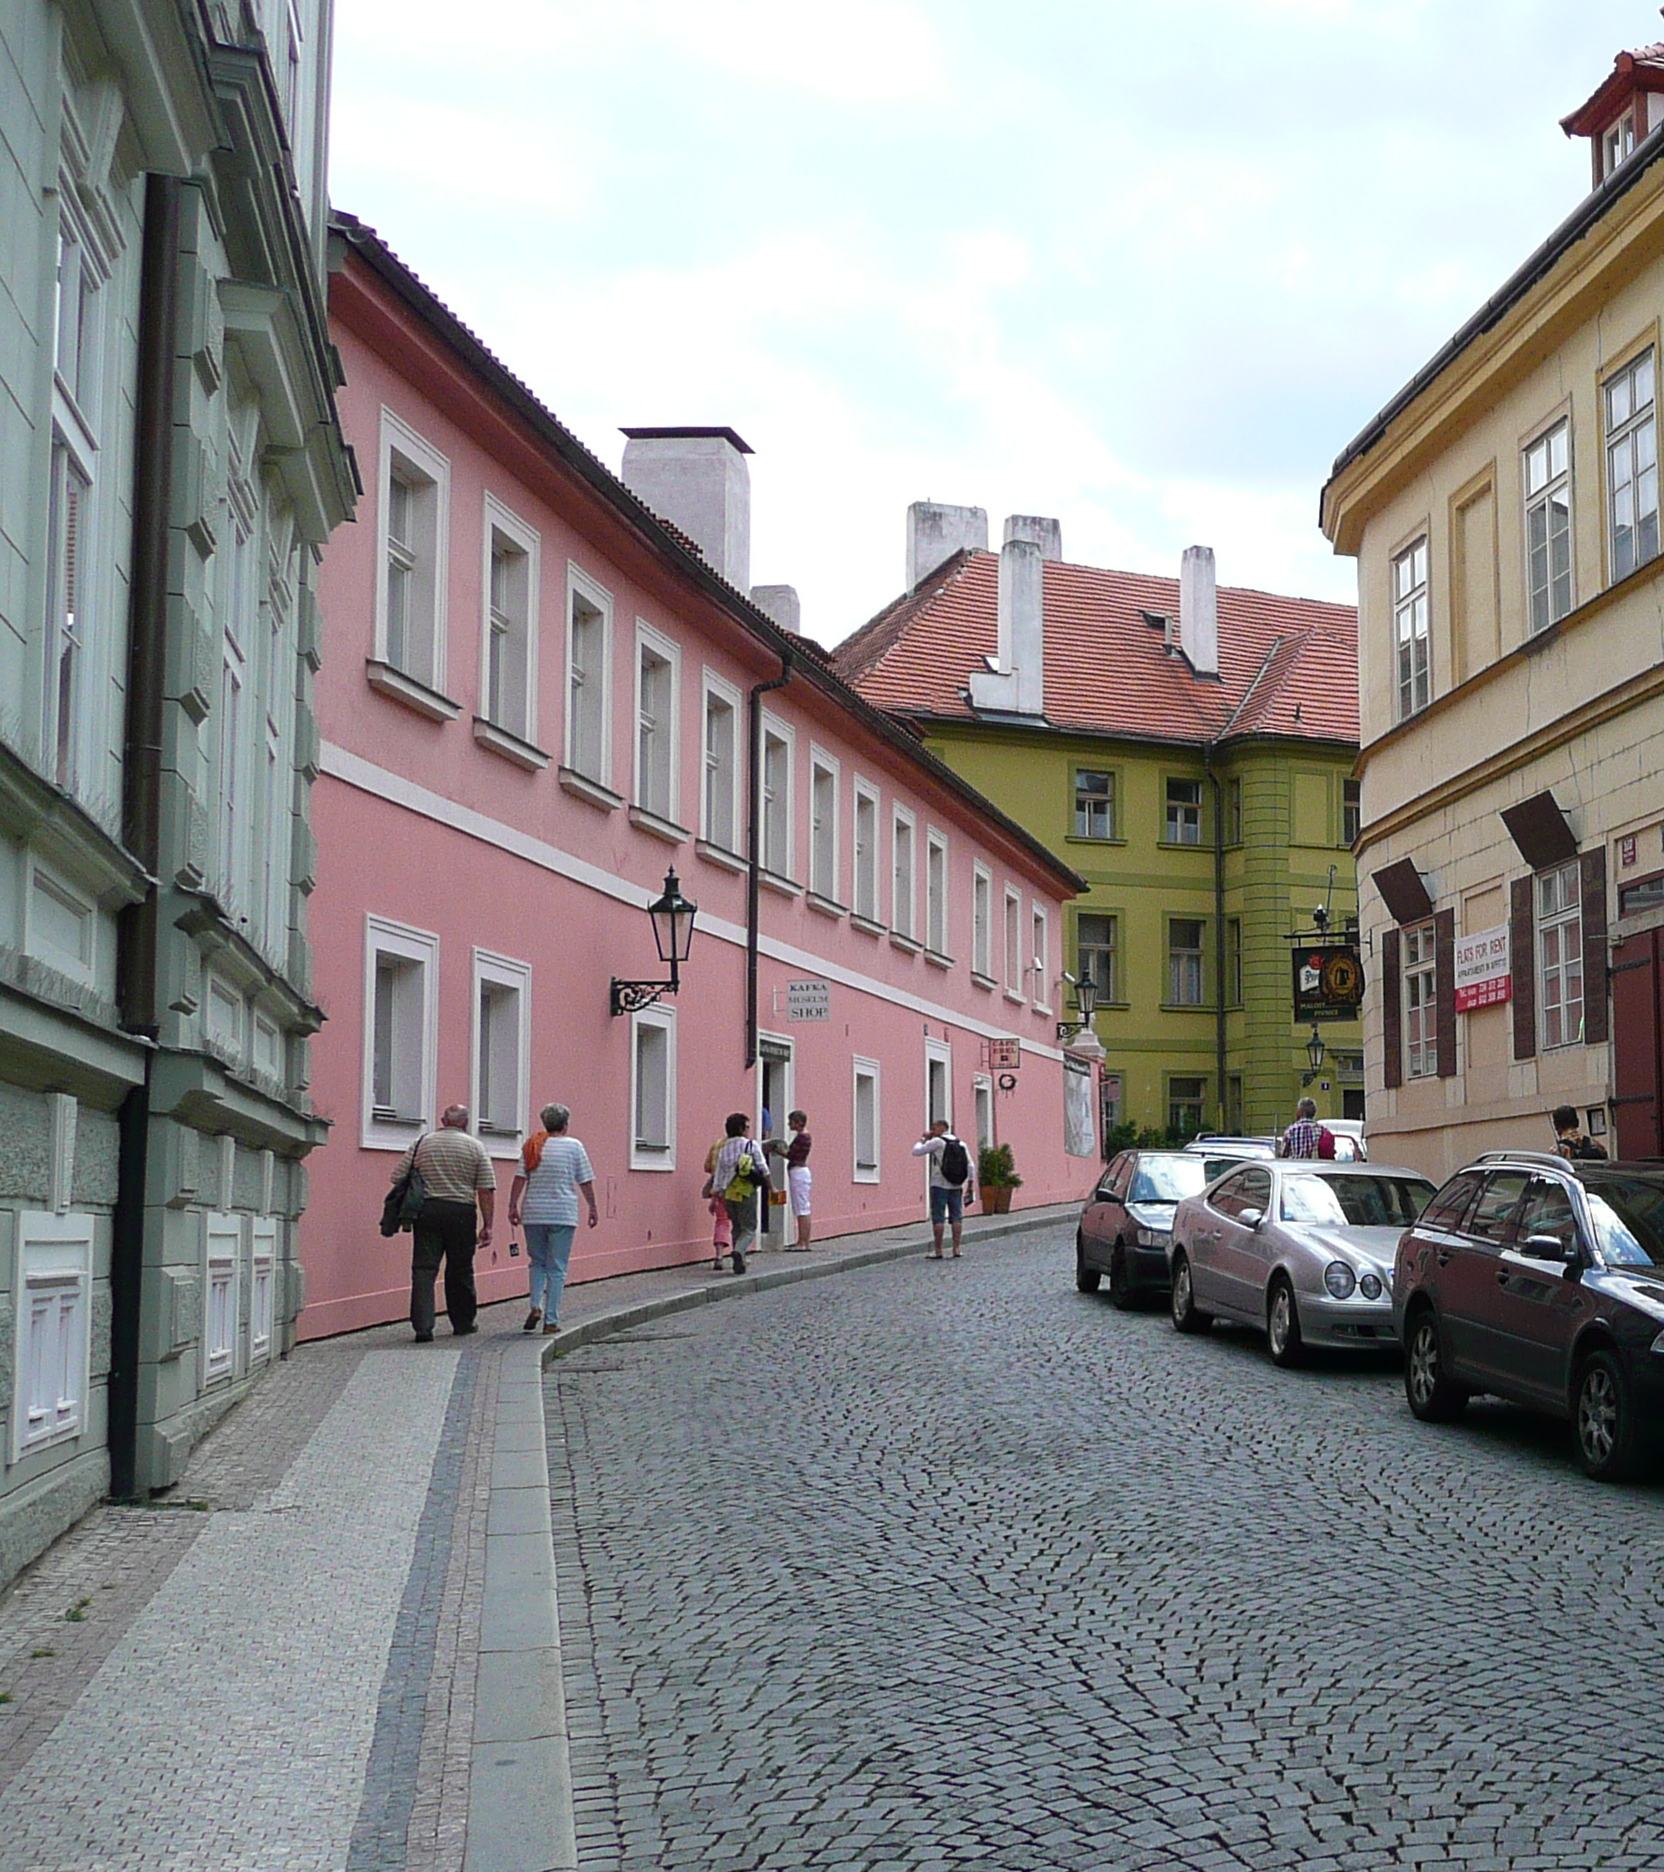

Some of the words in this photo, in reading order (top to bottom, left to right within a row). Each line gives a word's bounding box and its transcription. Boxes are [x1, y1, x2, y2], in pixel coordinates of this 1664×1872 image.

[1457, 946, 1474, 966] FLATS
[1475, 942, 1488, 960] FOR
[1489, 936, 1507, 956] RENT
[789, 983, 828, 992] KAFKA
[788, 995, 828, 1004] MUSEUM
[791, 1007, 828, 1018] SHOP
